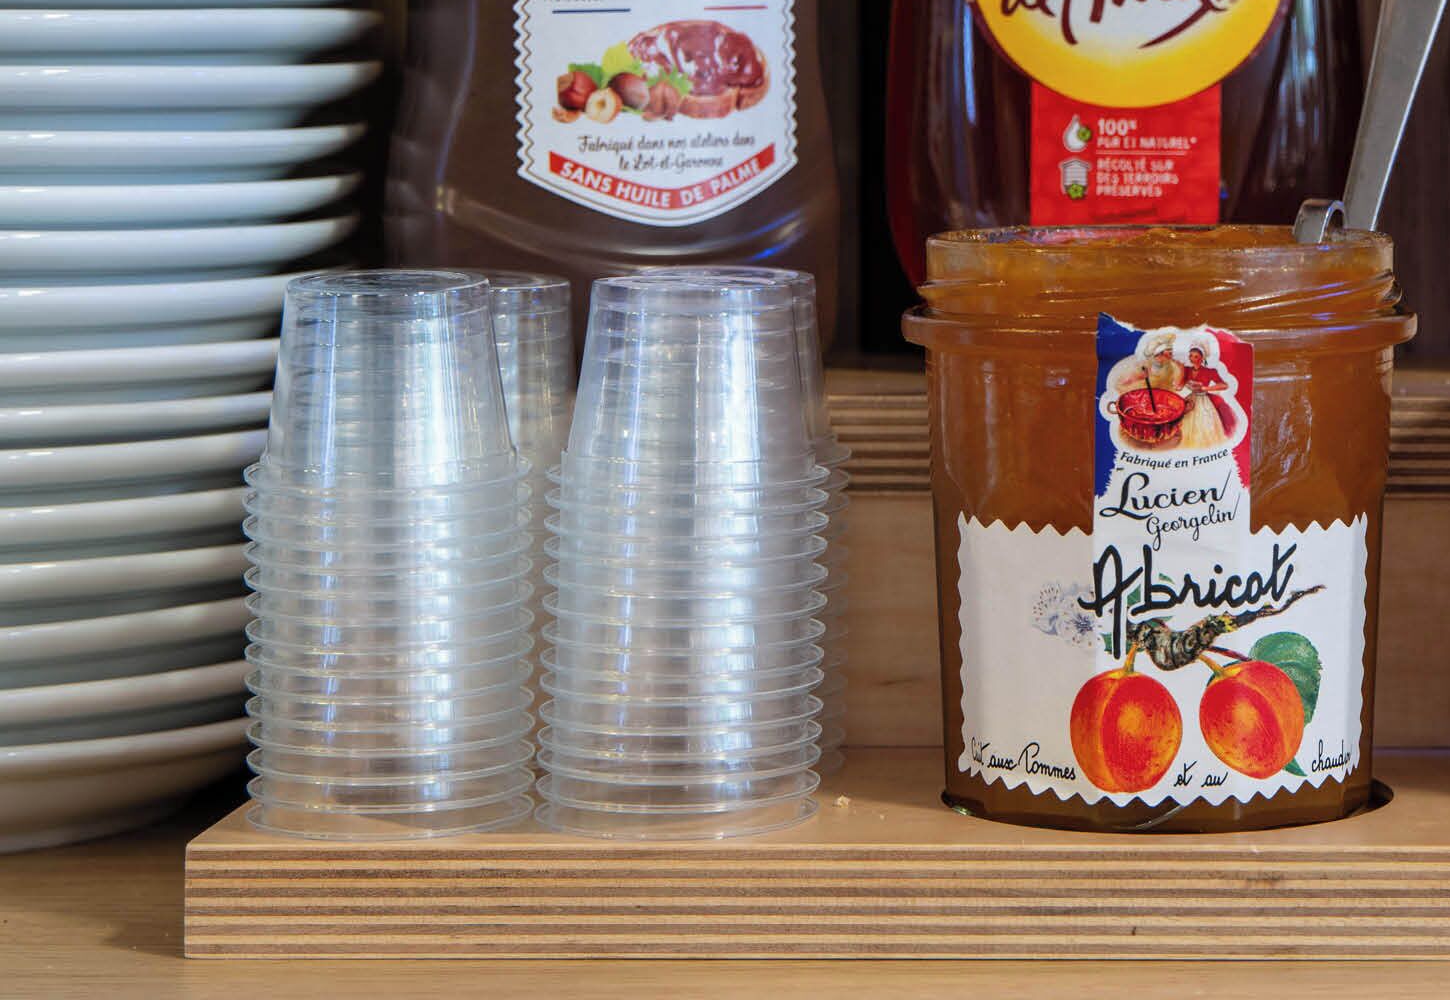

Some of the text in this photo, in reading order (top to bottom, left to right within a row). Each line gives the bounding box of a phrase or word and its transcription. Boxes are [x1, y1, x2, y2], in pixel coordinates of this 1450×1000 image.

[560, 156, 760, 208] SANS HUILE DE PALME
[1120, 448, 1229, 470] Fabriqué en France
[1100, 470, 1232, 520] Lucien
[1146, 493, 1241, 551] Georgelin
[1078, 543, 1297, 660] Abricot
[987, 754, 1018, 771] aux
[1017, 742, 1077, 781] Pommes
[1173, 760, 1198, 787] et
[1200, 771, 1229, 788] au
